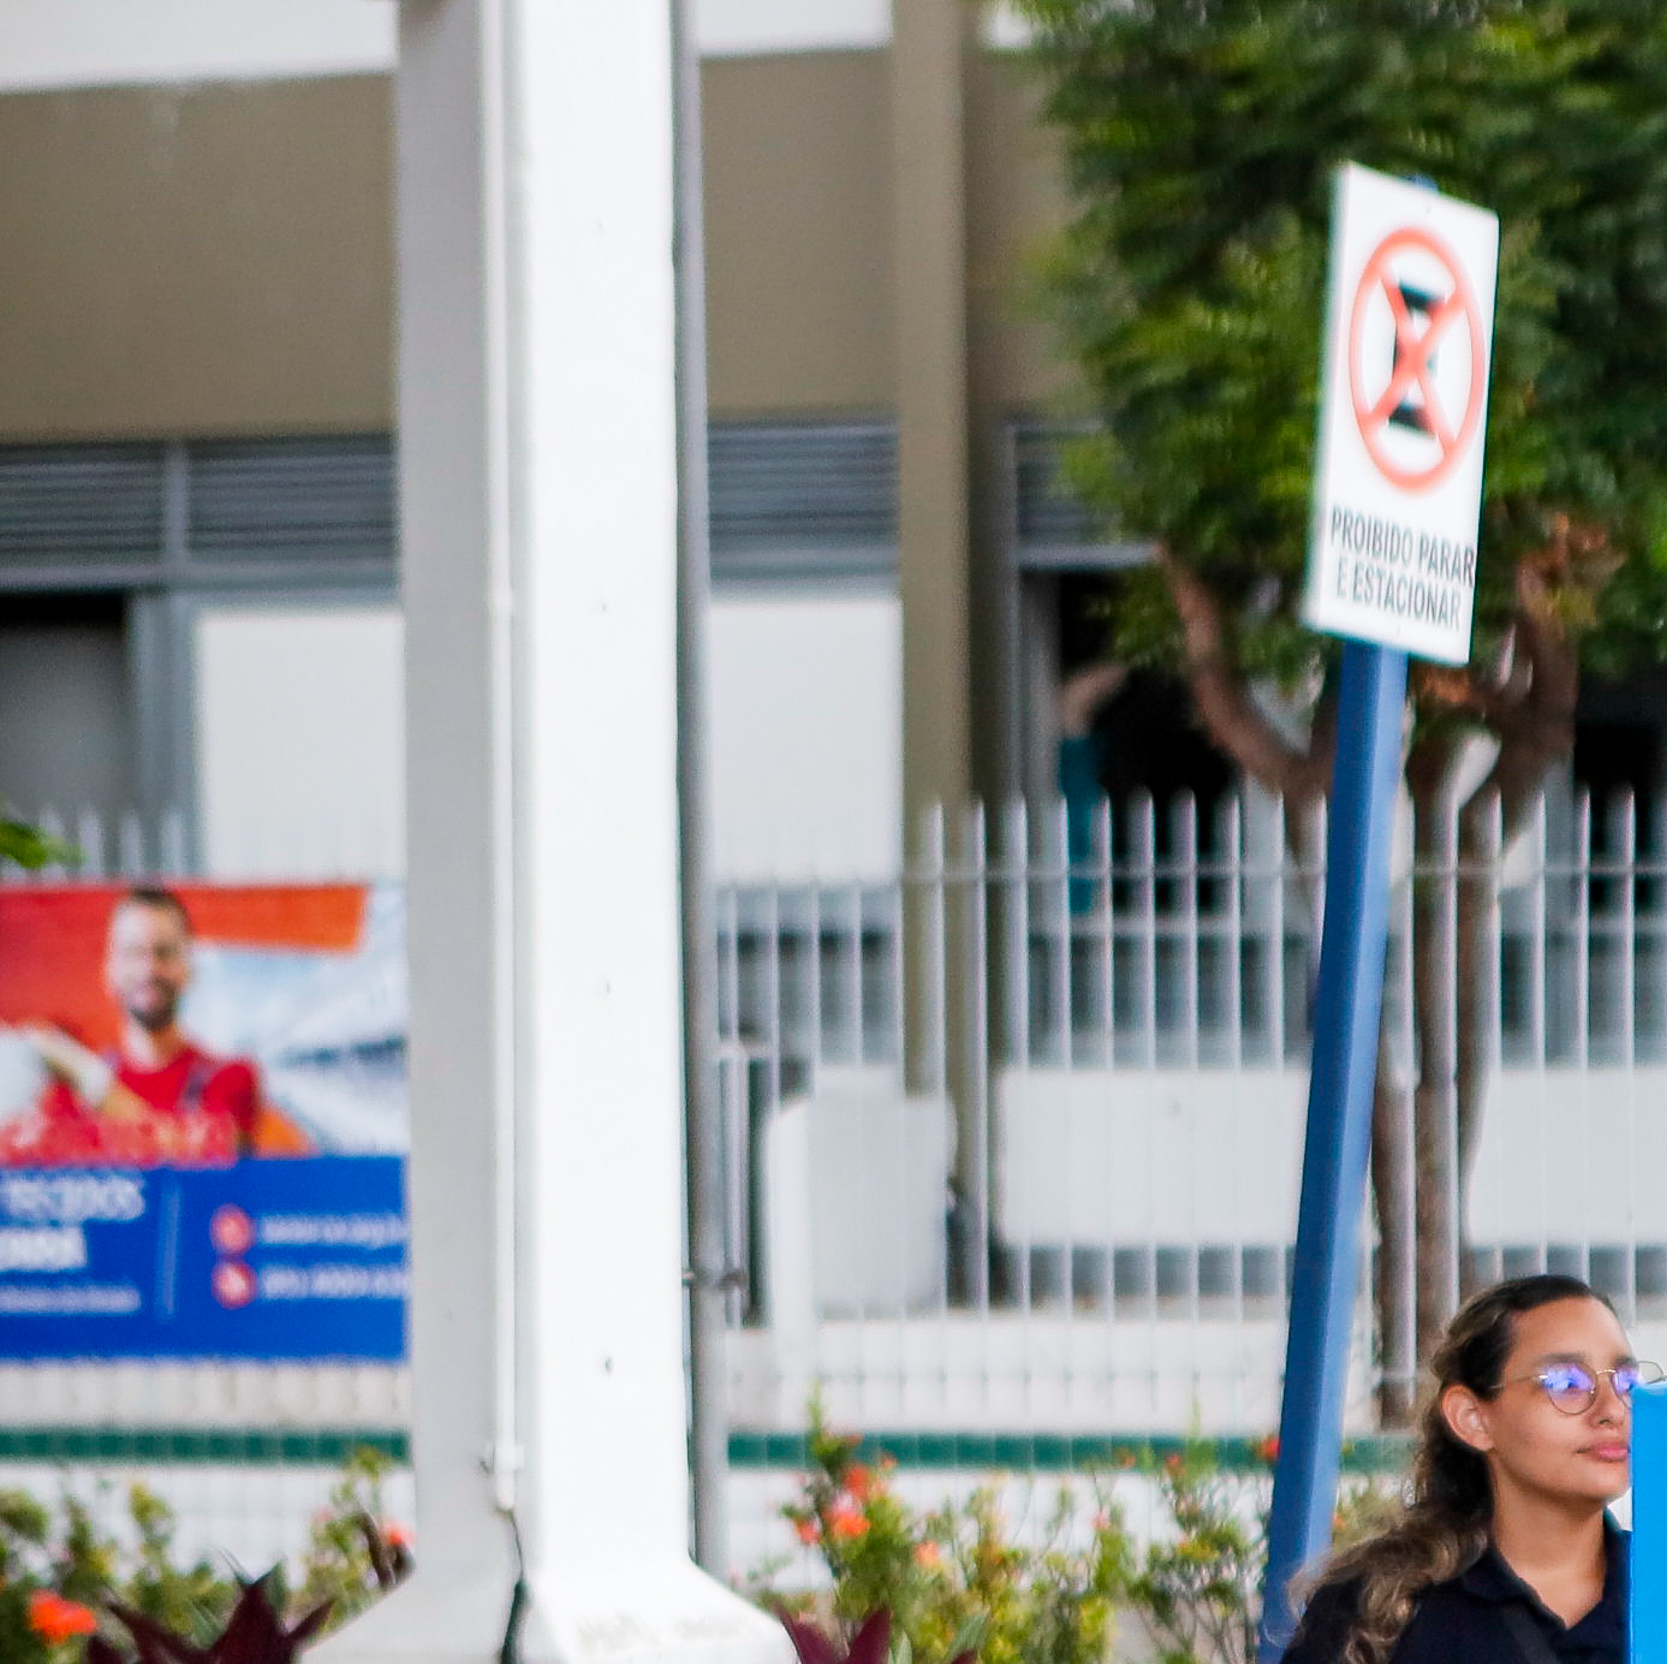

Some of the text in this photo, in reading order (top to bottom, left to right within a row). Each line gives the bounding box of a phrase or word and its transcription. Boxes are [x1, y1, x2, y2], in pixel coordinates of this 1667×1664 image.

[1331, 504, 1475, 588] PROIBIDO PARAR
[1337, 557, 1461, 631] E ESTACIONAR
